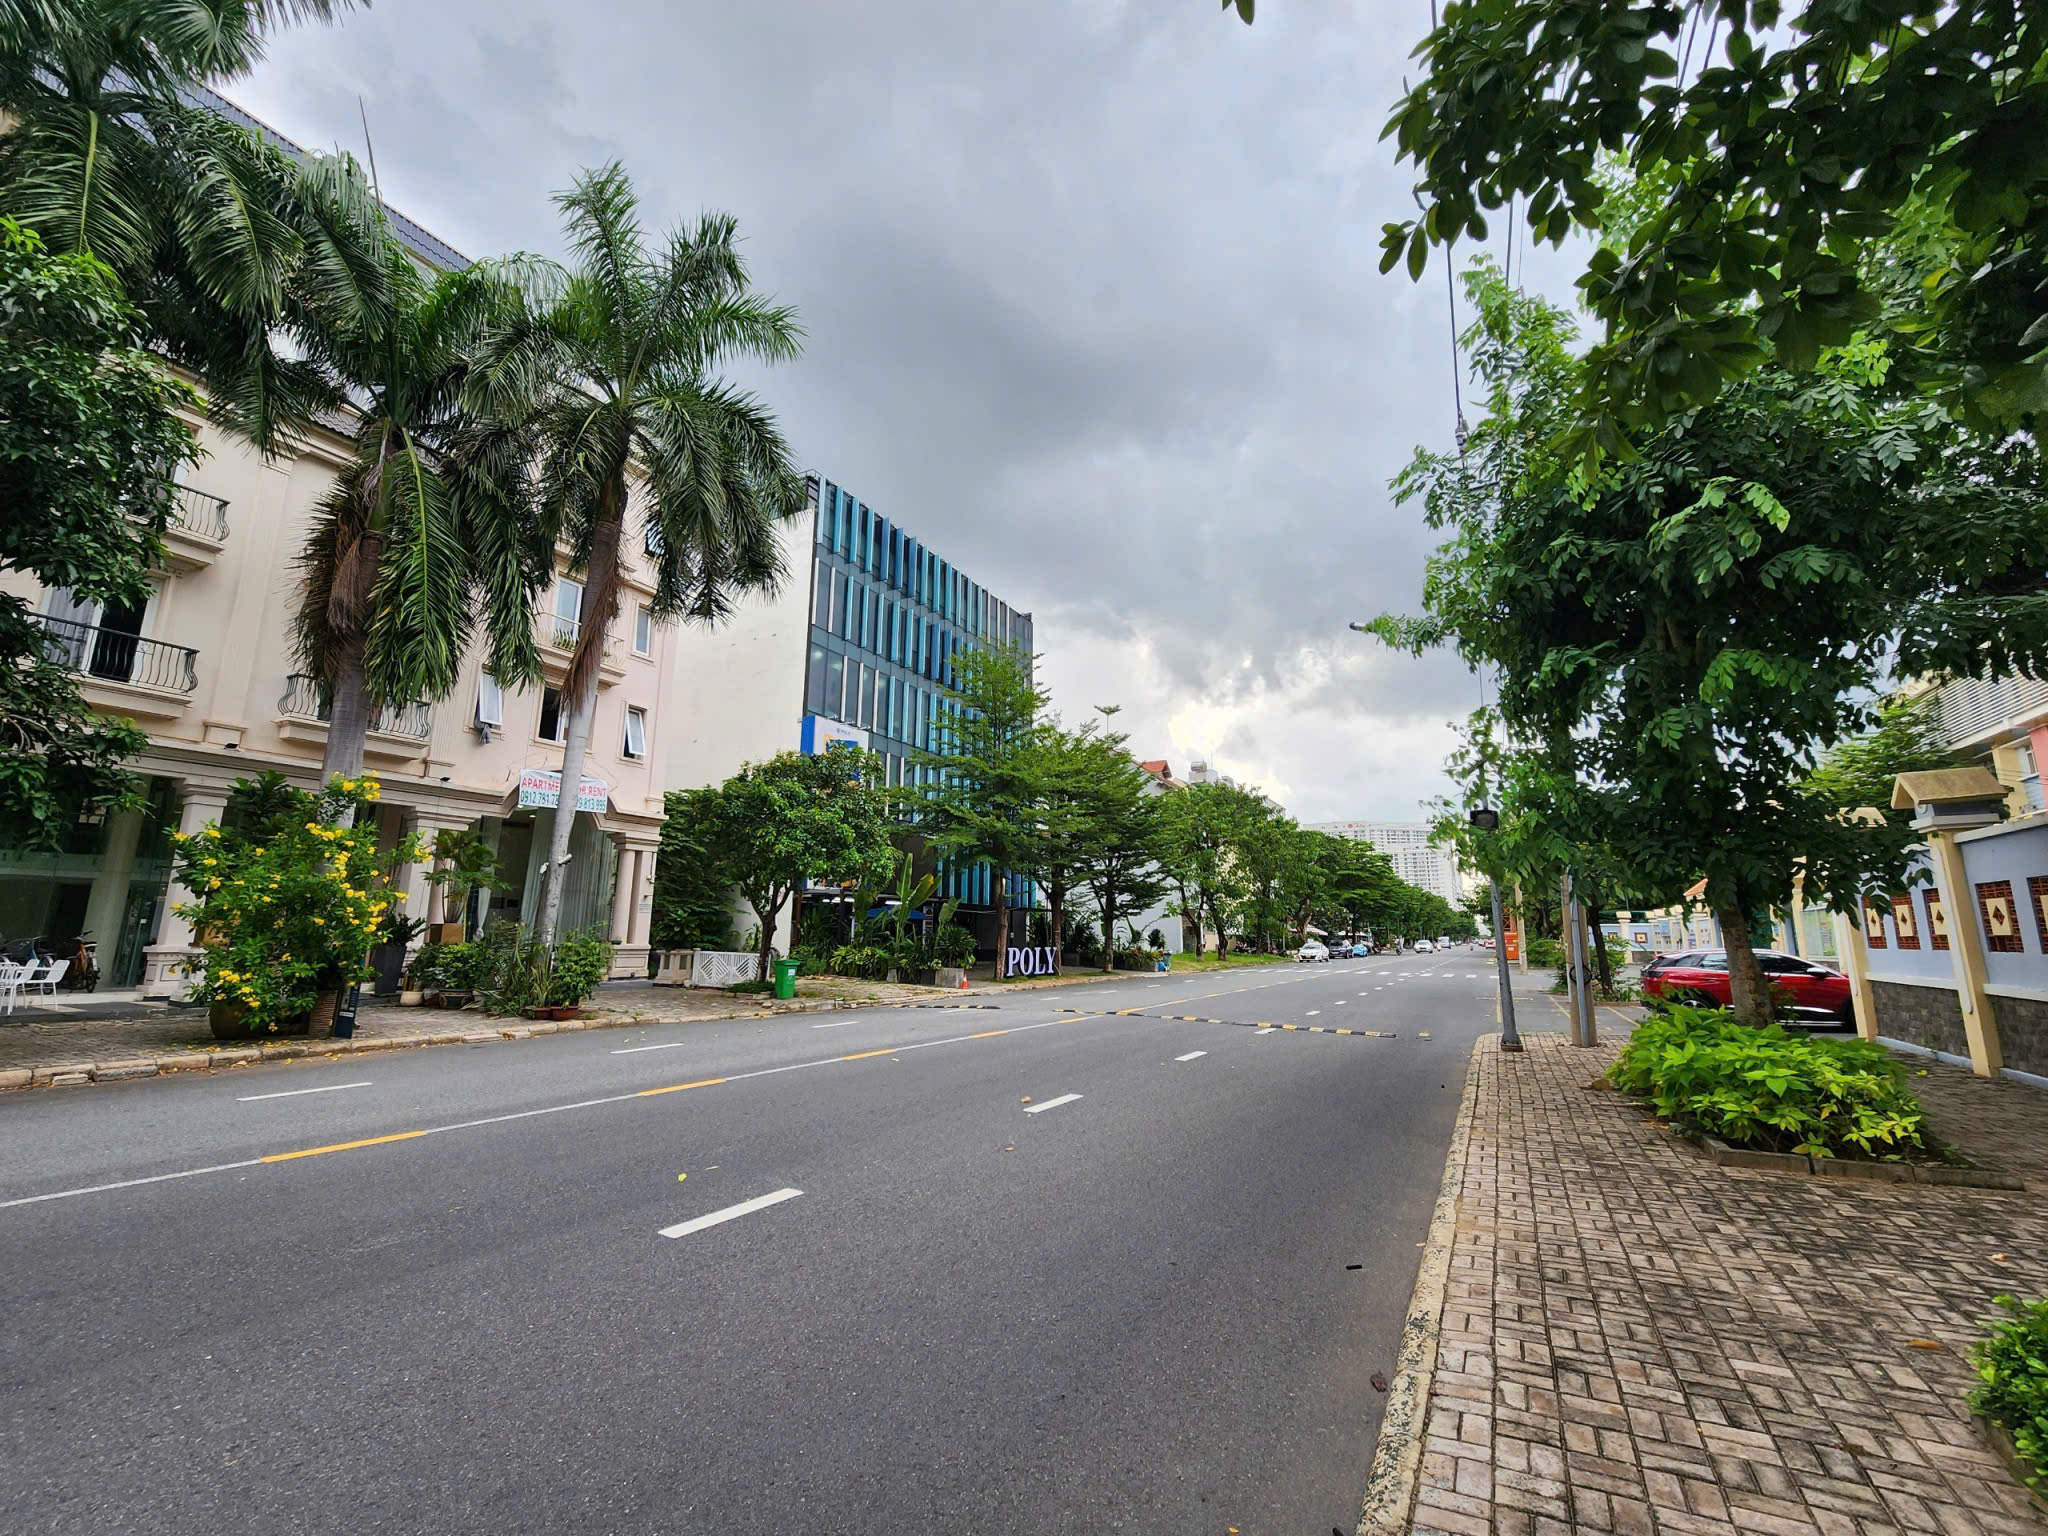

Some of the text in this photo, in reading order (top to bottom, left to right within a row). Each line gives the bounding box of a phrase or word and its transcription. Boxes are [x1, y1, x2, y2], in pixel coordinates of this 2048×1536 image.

[521, 790, 536, 803] 0912
[522, 777, 560, 792] APARTME
[588, 786, 606, 797] RENT
[1006, 947, 1057, 976] POLY
